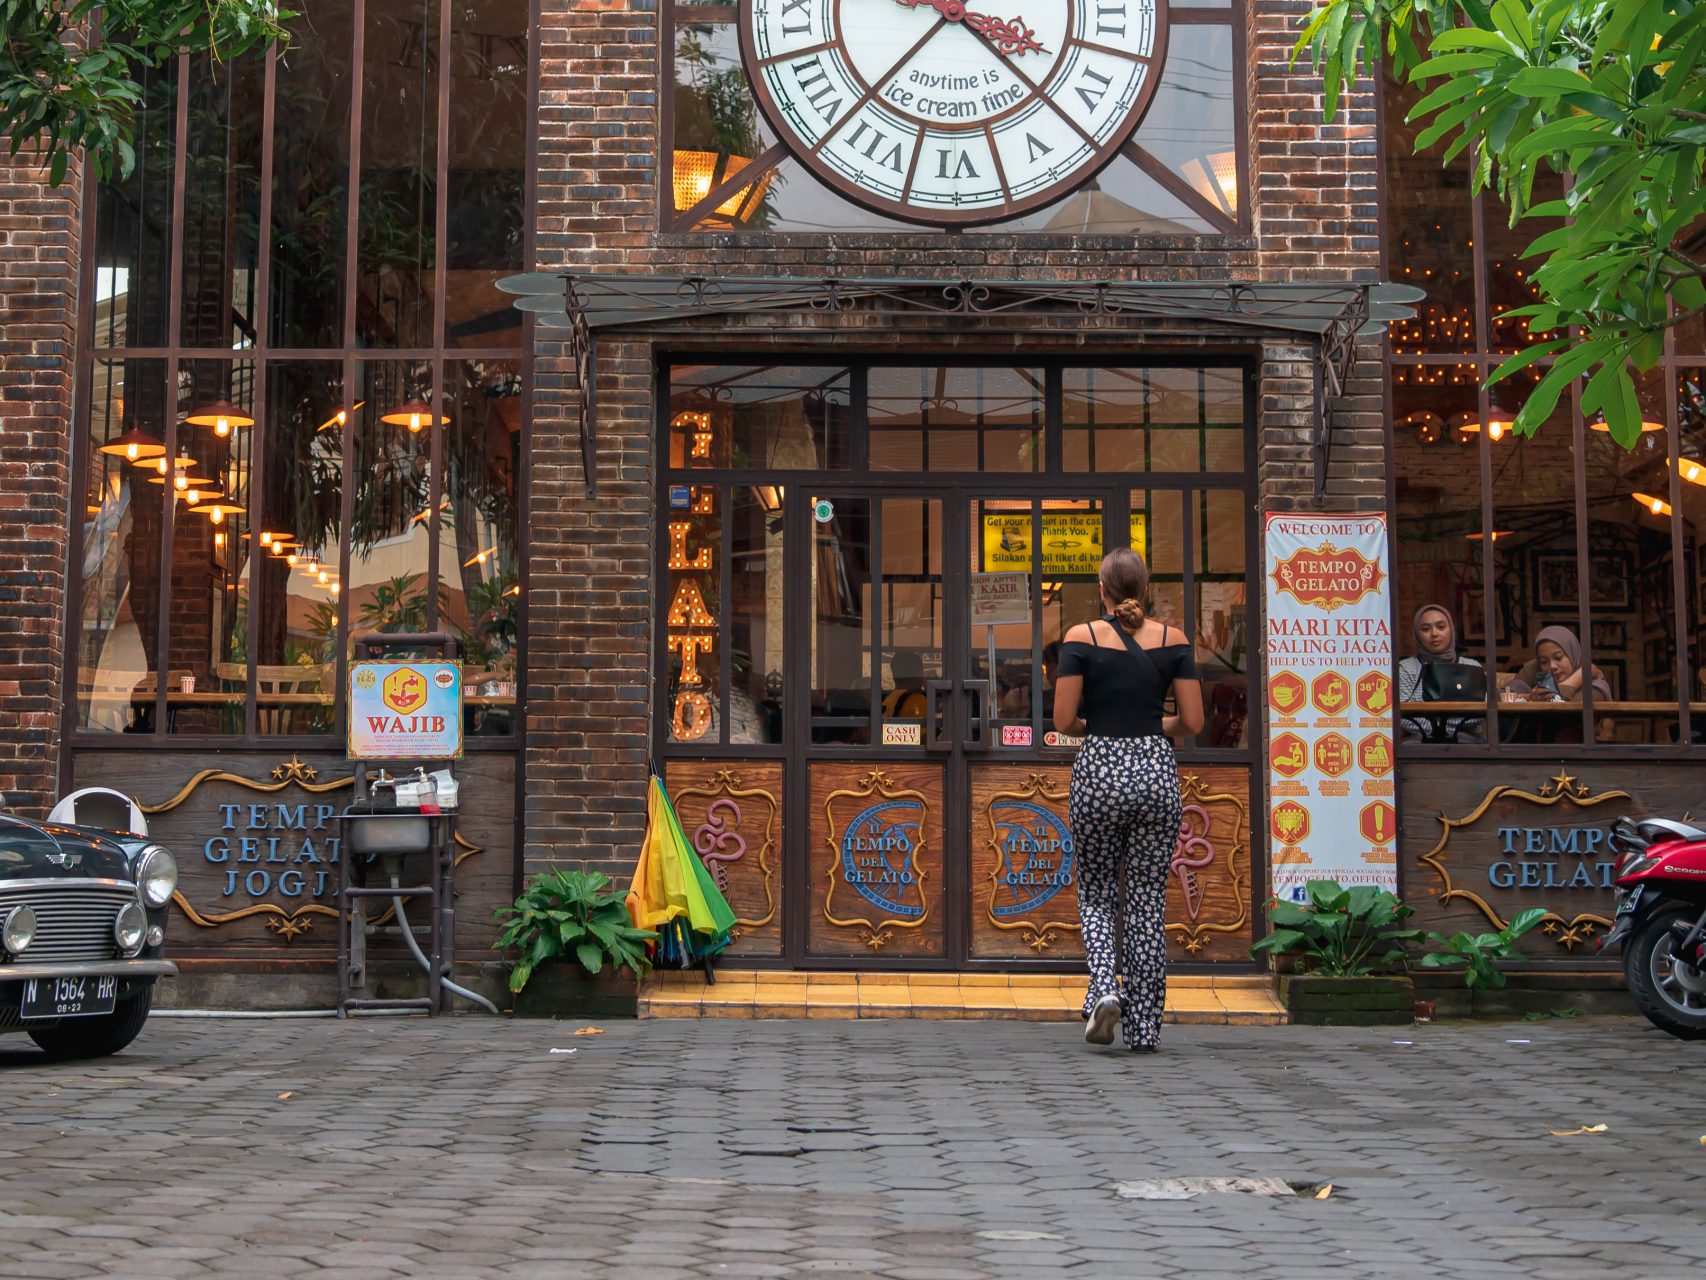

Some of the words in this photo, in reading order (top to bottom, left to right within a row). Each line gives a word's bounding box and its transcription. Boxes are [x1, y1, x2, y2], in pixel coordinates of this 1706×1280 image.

[909, 69, 979, 91] anytime
[982, 69, 1000, 85] is
[790, 54, 845, 127] VIII
[1073, 65, 1115, 115] IV
[884, 80, 914, 107] ice
[916, 97, 978, 118] cream
[981, 83, 1024, 113] time
[842, 117, 905, 175] VII
[1024, 131, 1055, 164] V
[934, 148, 981, 181] VI
[987, 517, 1002, 527] Get
[1004, 518, 1024, 528] your
[1059, 516, 1068, 526] in
[1069, 516, 1084, 526] the
[1278, 523, 1353, 536] WELCOME
[1355, 523, 1376, 536] TO
[1042, 526, 1067, 536] Thank
[1070, 526, 1089, 536] You.
[992, 553, 1026, 563] Silakan
[1028, 553, 1053, 563] abil
[1055, 553, 1077, 563] tiket
[1078, 553, 1087, 563] di
[1042, 563, 1065, 572] erima
[1067, 563, 1097, 572] Kasih.
[1297, 560, 1357, 574] TEMPO
[980, 583, 1019, 595] KASIR
[1295, 578, 1360, 592] GELATO
[1268, 618, 1330, 637] MARI
[1335, 618, 1391, 637] KITA
[1268, 639, 1337, 654] SALING
[1342, 638, 1391, 654] JAGA
[1270, 657, 1301, 666] HELP
[1301, 657, 1315, 666] US
[1318, 657, 1333, 666] TO
[1335, 657, 1365, 666] HELP
[1366, 657, 1390, 666] YOU
[366, 715, 446, 735] WAJIB
[886, 726, 916, 735] CASH
[886, 734, 917, 743] ONLY
[218, 803, 352, 830] TEMP
[844, 837, 910, 852] TEMPO
[1007, 838, 1074, 853] TEMPO
[861, 857, 887, 868] DEL
[1028, 859, 1055, 870] DEL
[844, 870, 913, 884] GELATO
[1006, 872, 1073, 886] GELATO
[1488, 861, 1616, 889] GELAT
[222, 870, 339, 897] JOGJ
[27, 978, 38, 1003] N
[54, 976, 86, 1003] 1564
[97, 975, 115, 999] HR
